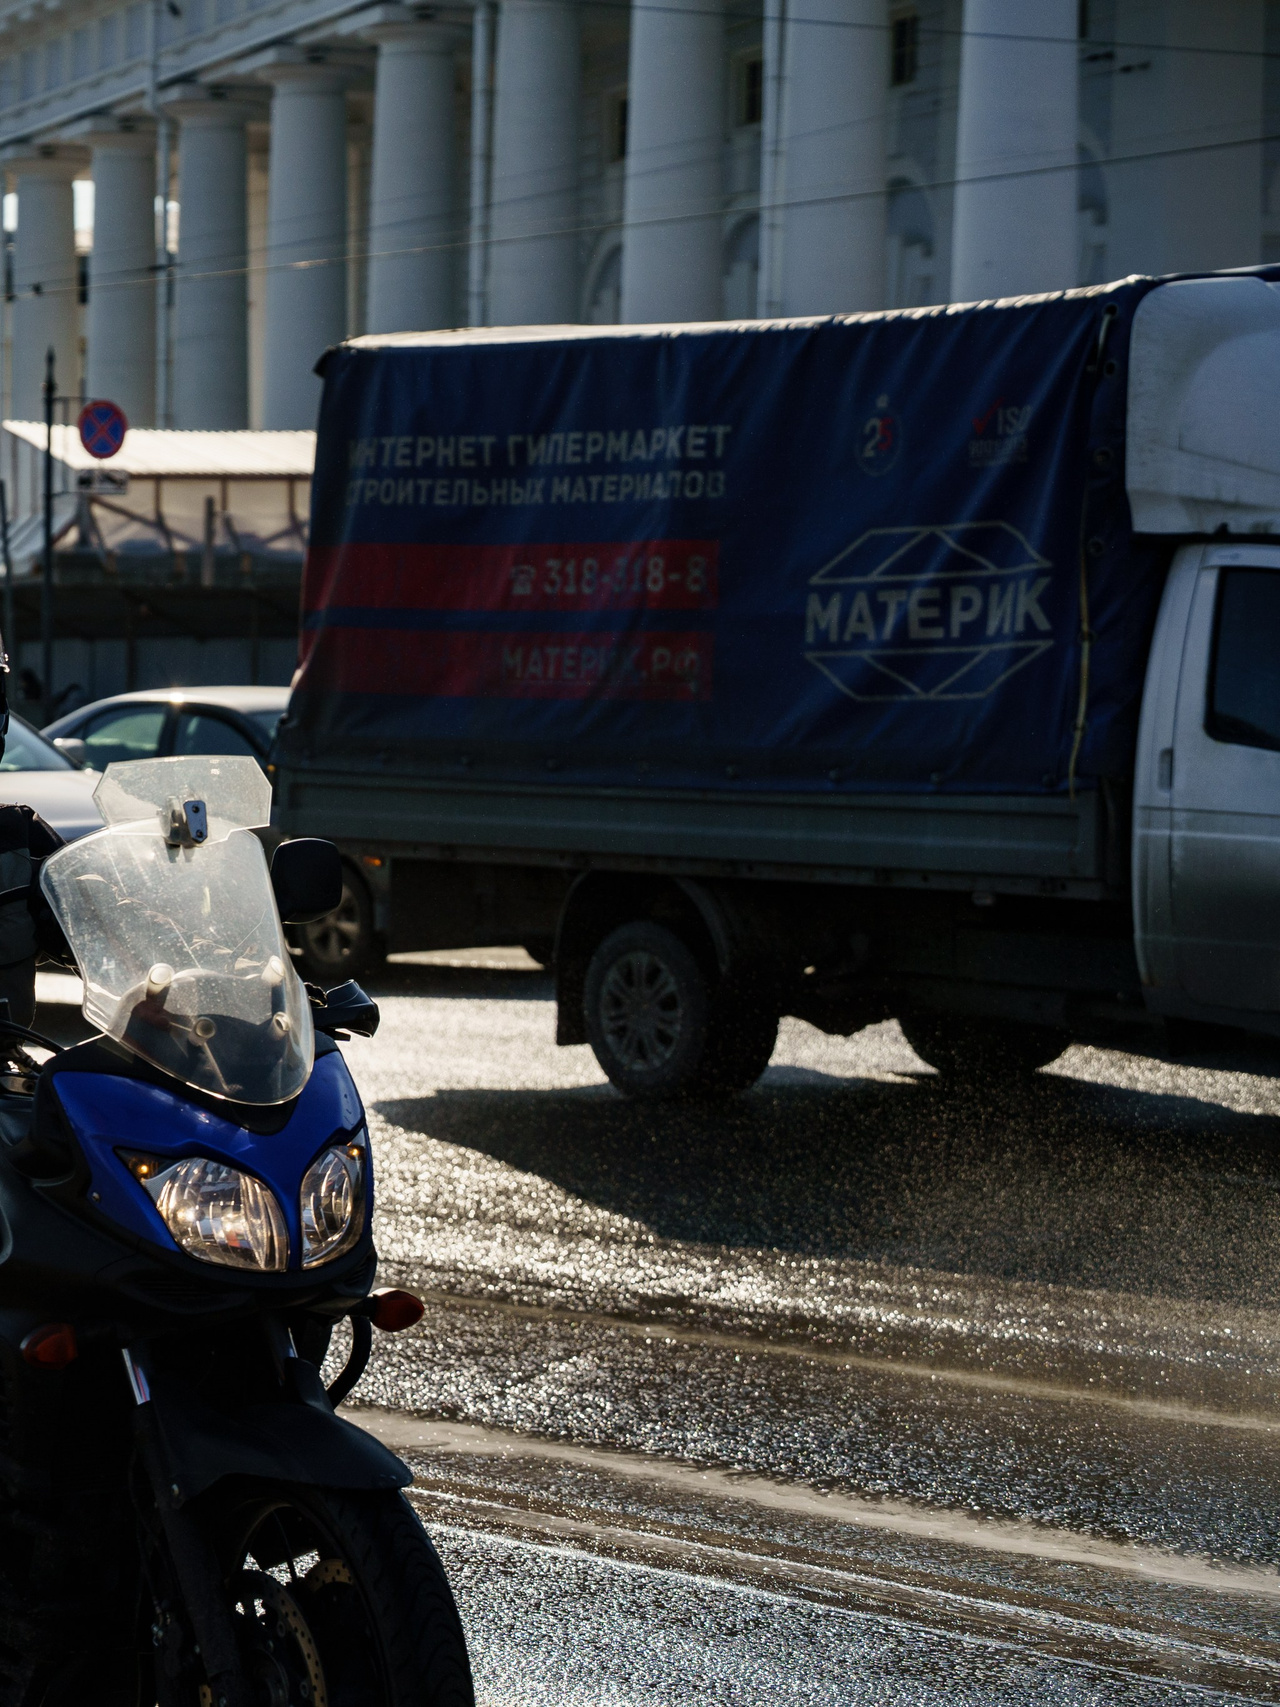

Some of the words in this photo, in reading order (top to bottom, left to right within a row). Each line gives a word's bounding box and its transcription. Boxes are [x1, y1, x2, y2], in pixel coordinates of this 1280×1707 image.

[507, 424, 732, 467] ГИПЕРМАРКЕТ
[862, 416, 895, 458] 25
[542, 554, 708, 596] 318-318-8
[804, 576, 1053, 644] МАТЕРИК
